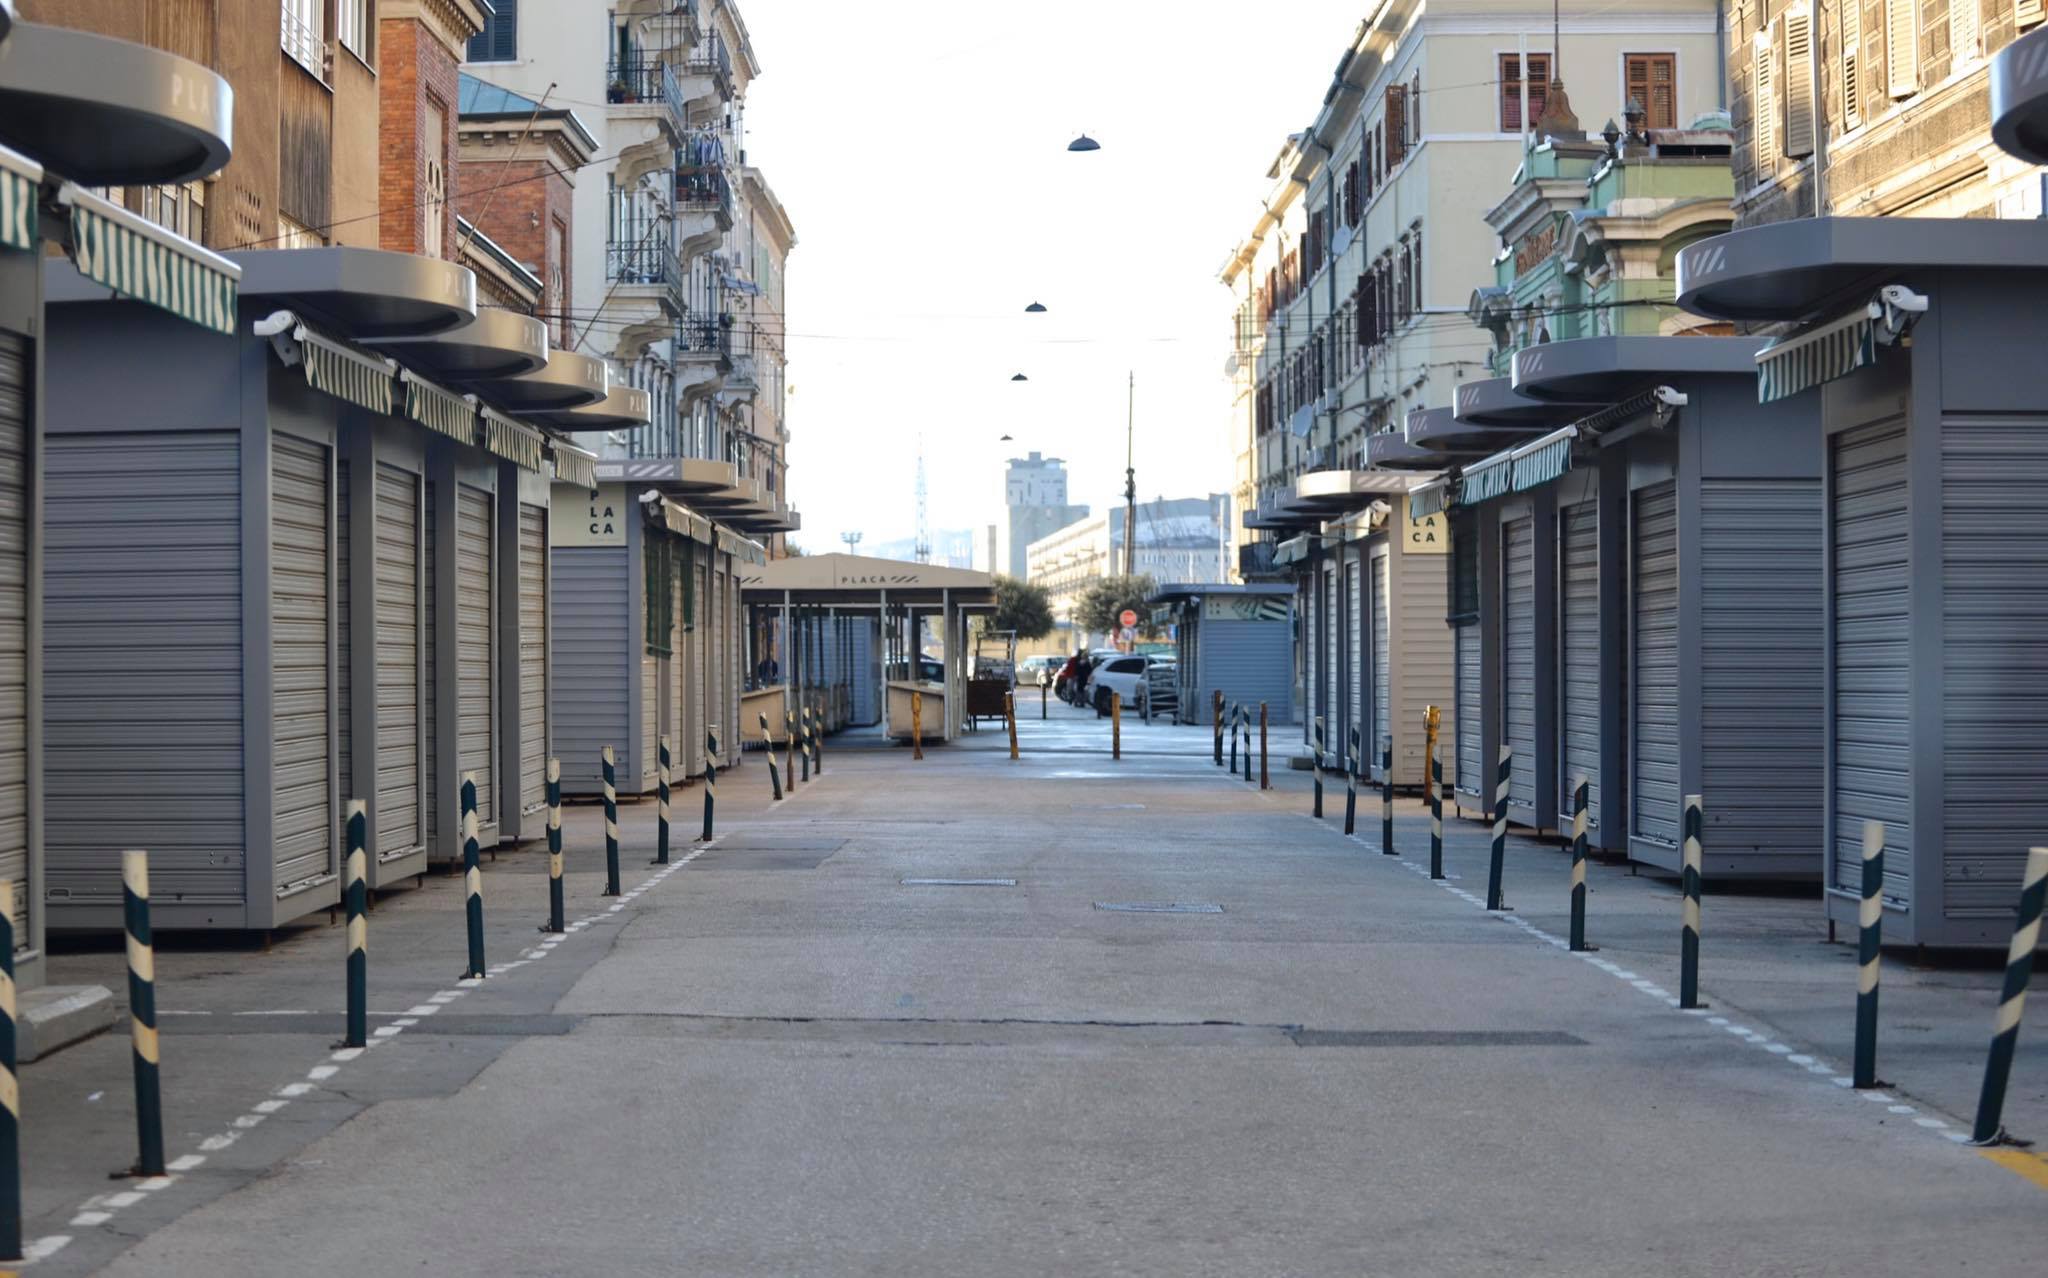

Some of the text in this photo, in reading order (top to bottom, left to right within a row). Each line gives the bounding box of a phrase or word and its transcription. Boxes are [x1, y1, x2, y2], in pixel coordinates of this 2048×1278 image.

[590, 507, 614, 518] LA
[589, 523, 614, 534] CA
[1412, 533, 1435, 543] CA
[841, 576, 887, 584] PLACA
